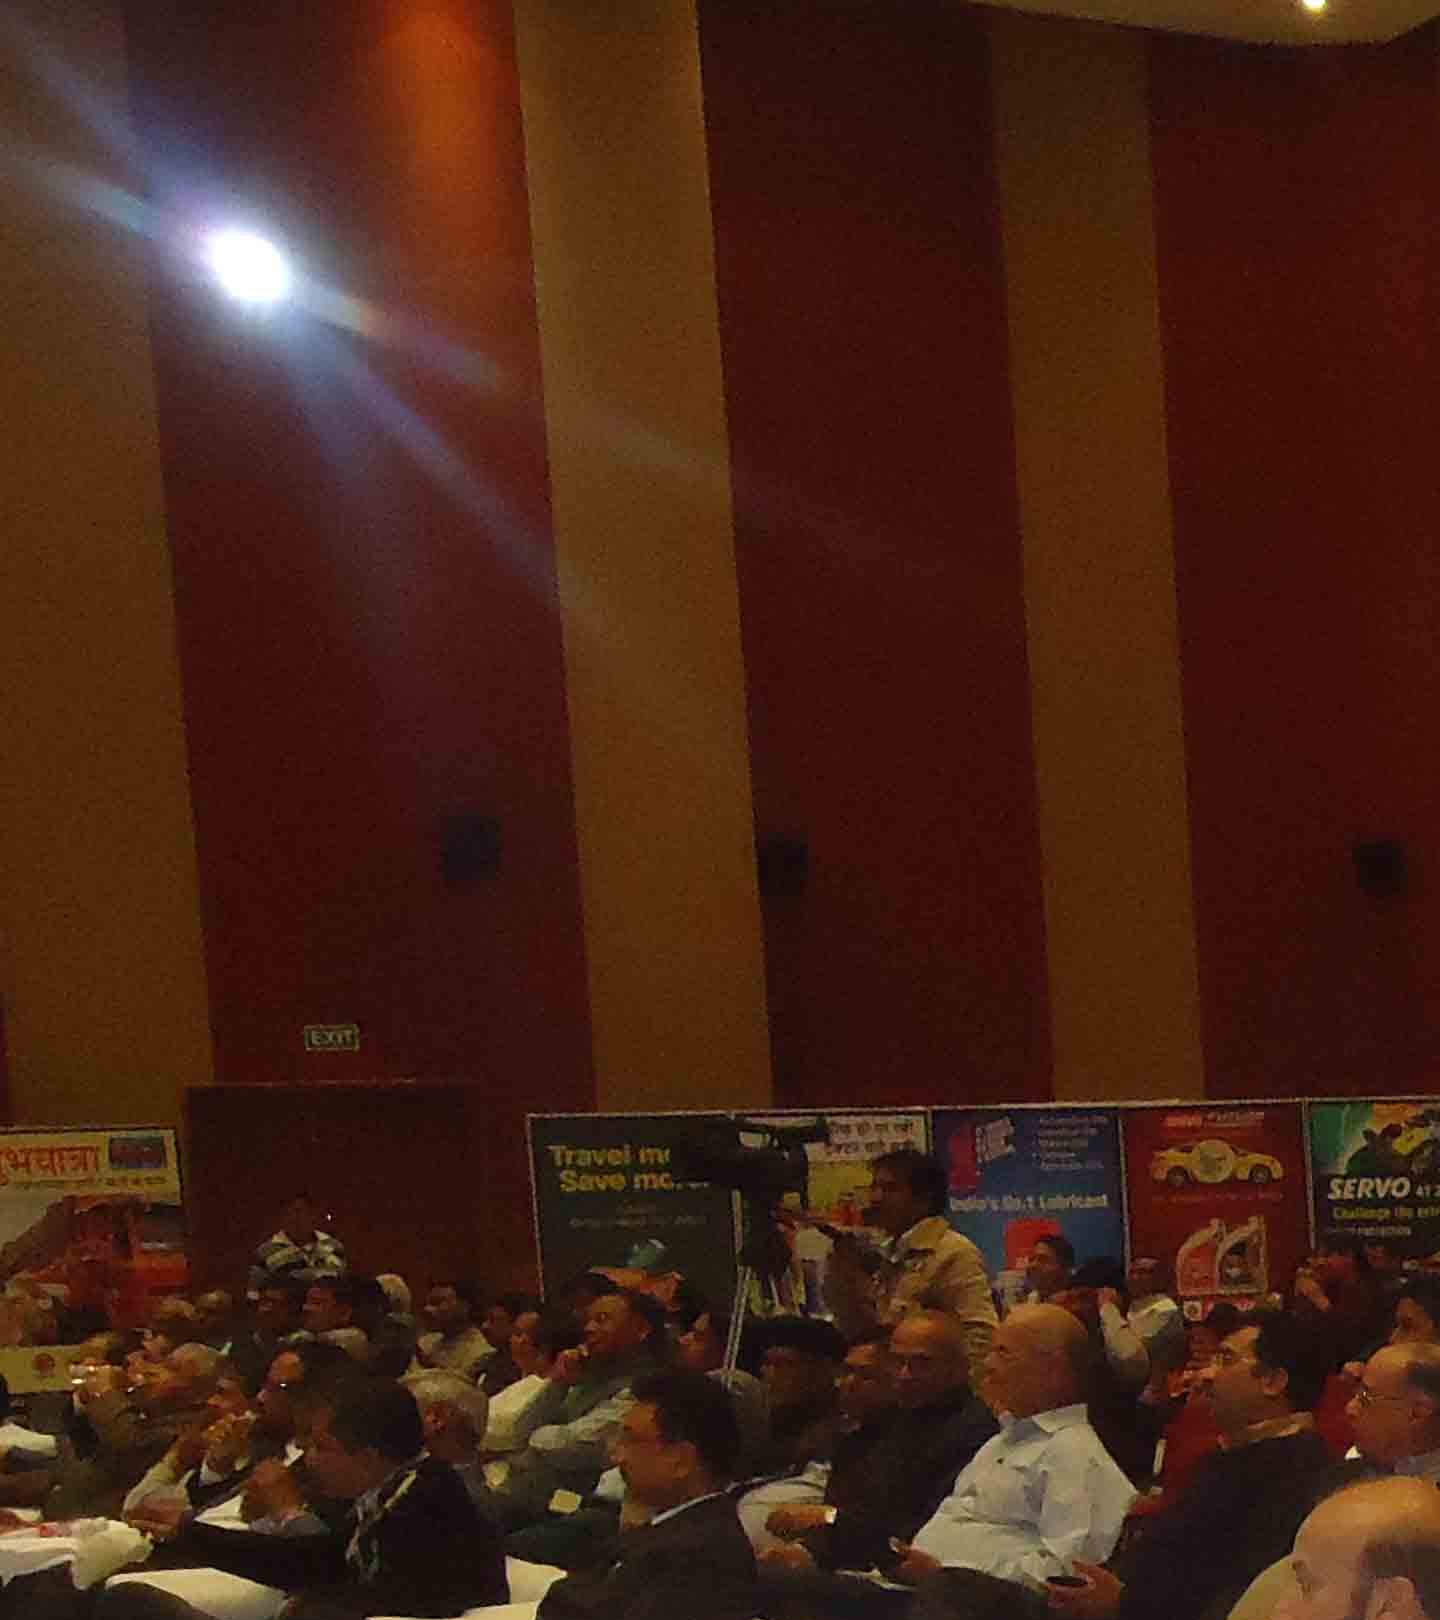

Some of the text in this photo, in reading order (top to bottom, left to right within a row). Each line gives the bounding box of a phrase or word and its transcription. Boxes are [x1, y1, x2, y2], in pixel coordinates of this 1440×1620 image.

[311, 1030, 353, 1047] EXIT
[545, 1144, 633, 1168] Travel
[559, 1169, 627, 1192] Save
[1328, 1177, 1411, 1200] SERVO
[1333, 1207, 1391, 1221] Challenge
